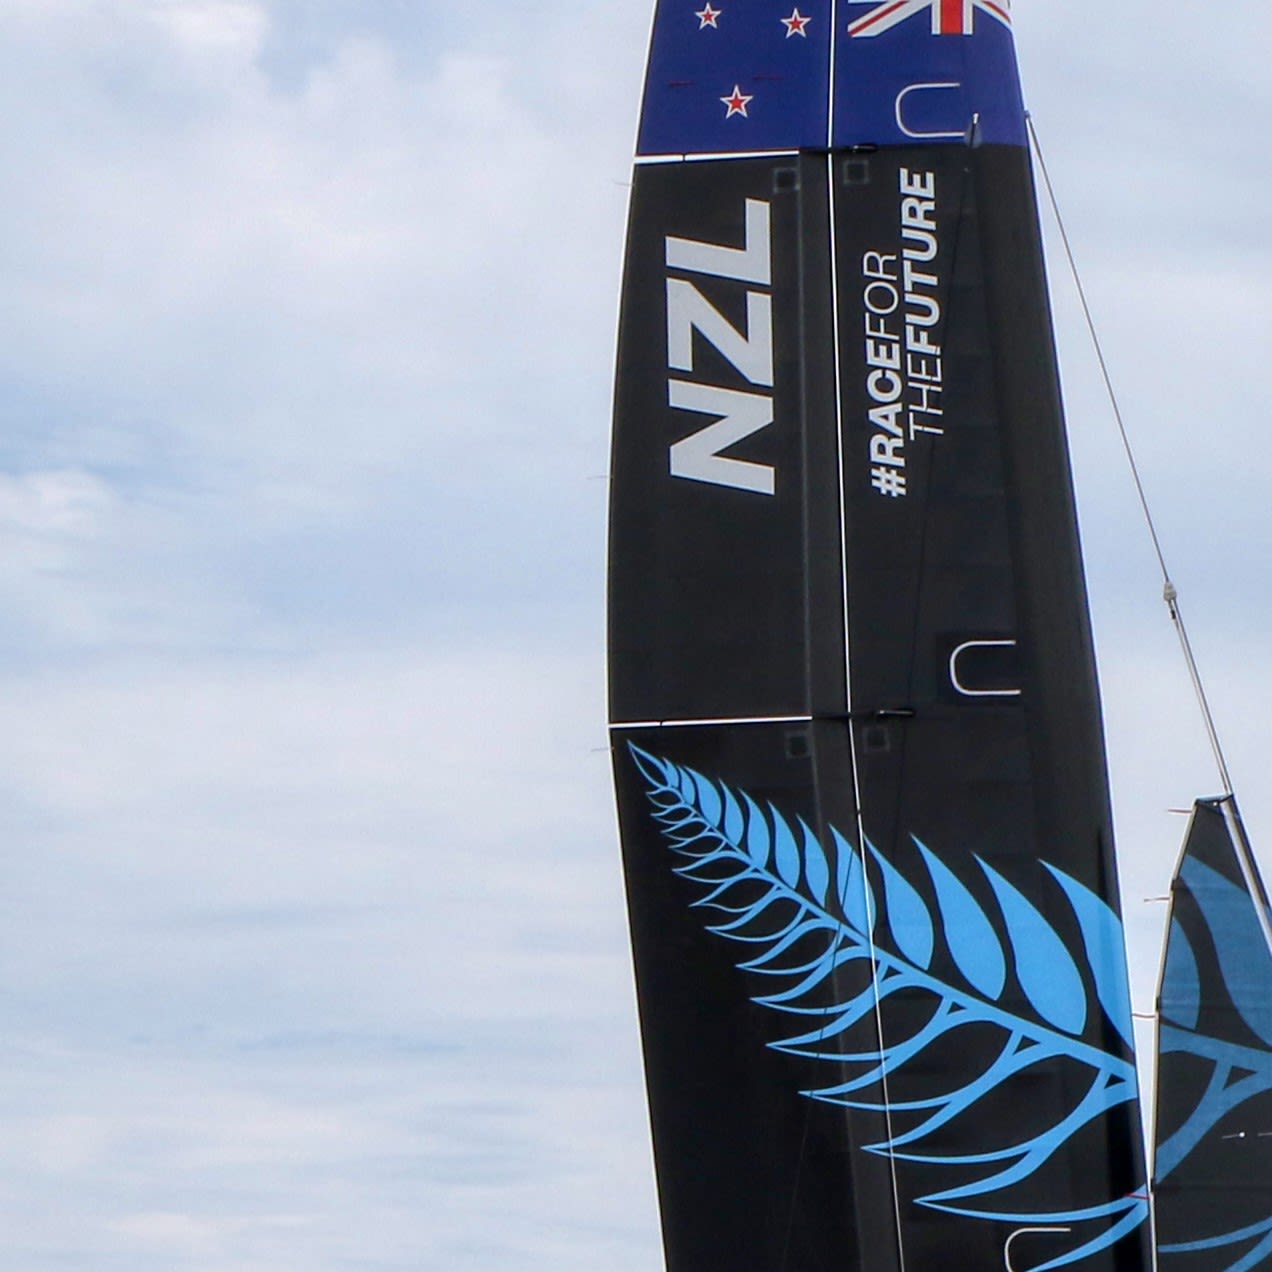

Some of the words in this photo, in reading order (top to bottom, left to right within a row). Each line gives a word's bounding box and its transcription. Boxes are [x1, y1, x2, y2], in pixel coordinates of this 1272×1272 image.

[665, 198, 774, 495] NZL
[863, 249, 907, 498] #RACEFOR
[900, 167, 944, 441] THEFUTURE
